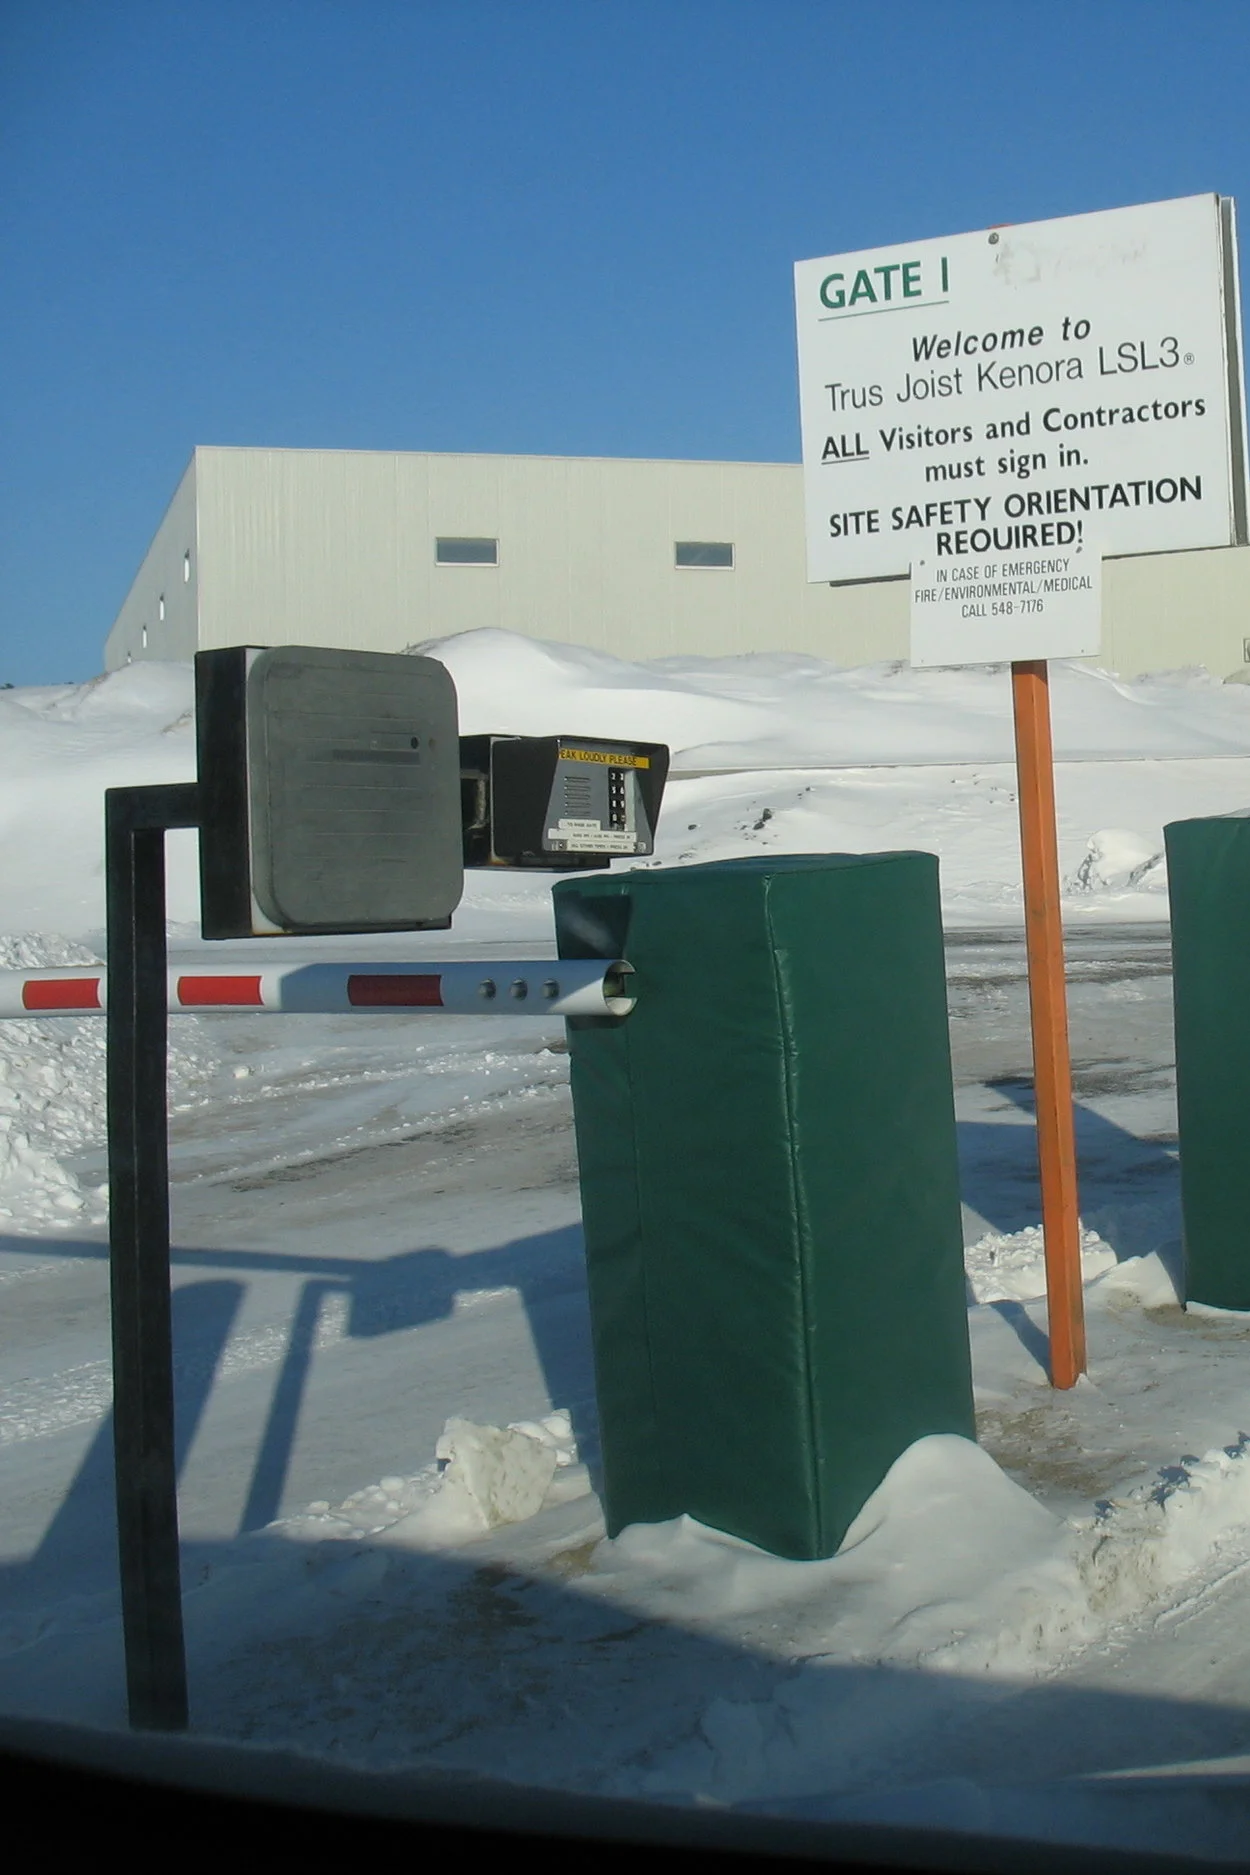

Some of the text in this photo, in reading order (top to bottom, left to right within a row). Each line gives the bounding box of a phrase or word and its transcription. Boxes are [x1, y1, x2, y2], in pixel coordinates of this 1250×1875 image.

[820, 260, 922, 309] GATE
[913, 316, 1091, 362] Welcome to
[825, 382, 883, 412] Trus
[896, 366, 963, 403] Joist
[976, 356, 1083, 392] Kenora
[821, 398, 1206, 461] ALL Visitors and Contractors
[925, 442, 1089, 483] must sign in.
[829, 475, 1203, 537] SITE SAFETY ORIENTATION
[936, 558, 1070, 583] IN CASE OF EMERGENCY
[961, 598, 1044, 618] CALL 548-7176
[560, 749, 637, 766] EAK LOUDLY PLEASE
